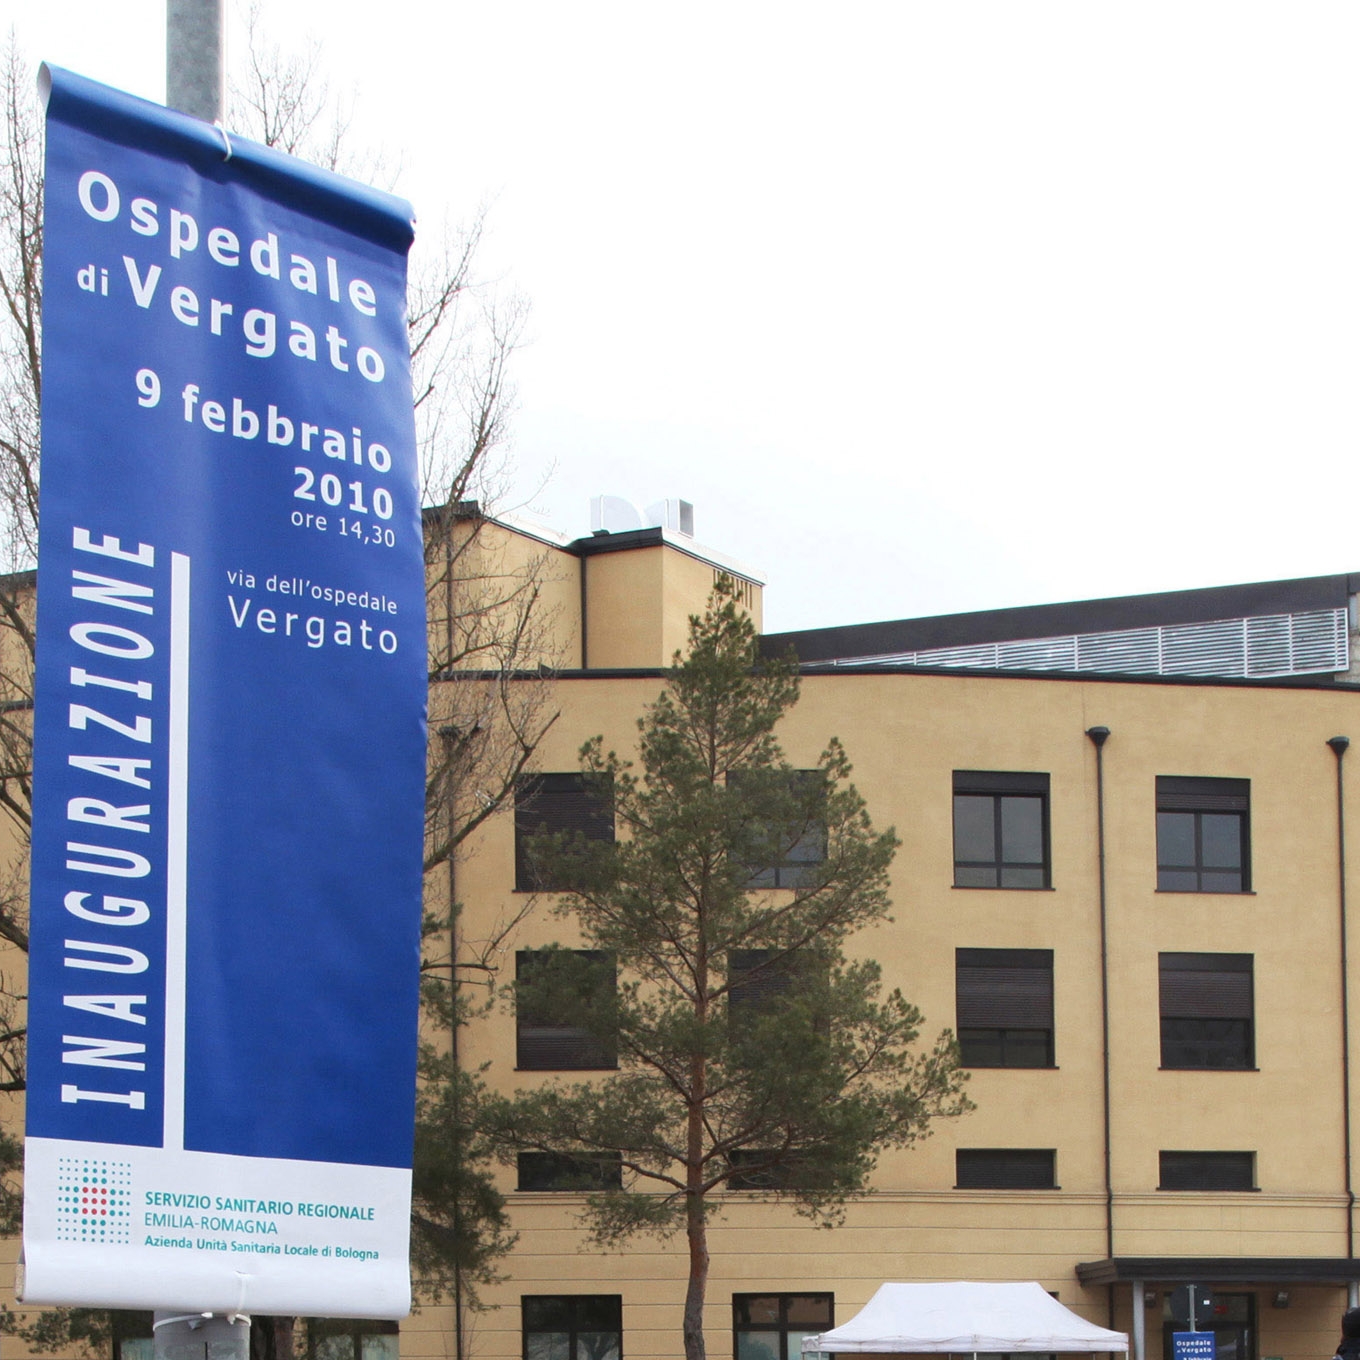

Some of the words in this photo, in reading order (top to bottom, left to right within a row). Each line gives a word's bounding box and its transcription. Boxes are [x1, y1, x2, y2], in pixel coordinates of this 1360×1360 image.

[76, 169, 379, 318] Ospedale
[76, 263, 109, 297] di
[122, 254, 387, 384] Vergato
[135, 368, 162, 408] 9
[181, 383, 393, 474] febbraio
[293, 467, 394, 520] 2010
[290, 510, 328, 531] ore
[338, 517, 396, 548] 14,30
[227, 570, 257, 589] via
[265, 572, 398, 616] dell'ospedale
[227, 594, 399, 655] Vergato
[60, 525, 156, 1110] INAUGURAZIONE
[144, 1190, 211, 1210] SERVIZIO
[215, 1195, 294, 1216] SANITARIO
[297, 1201, 375, 1221] REGIONALE
[144, 1211, 278, 1235] EMILIA-ROMAGNA
[144, 1234, 193, 1249] Azienda
[196, 1237, 228, 1252] Unità
[230, 1239, 281, 1255] Sanitaria
[284, 1243, 319, 1257] Locale
[321, 1244, 332, 1258] di
[335, 1246, 379, 1263] Bologna
